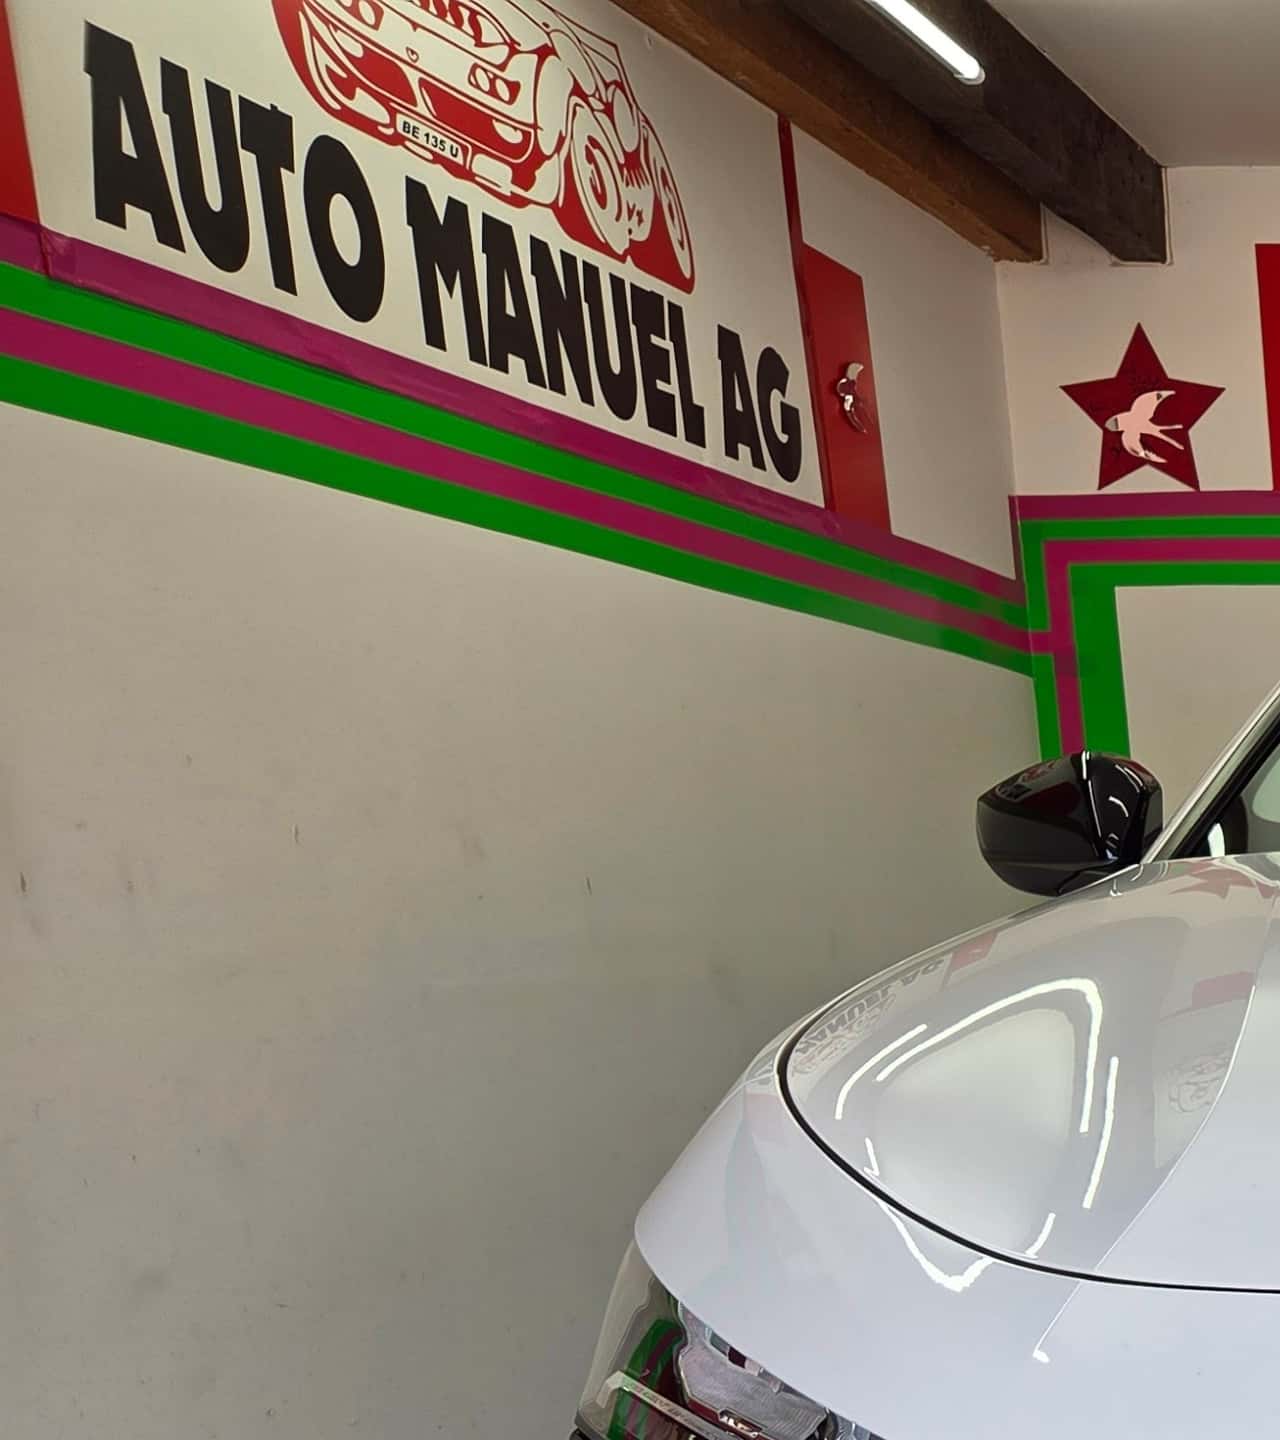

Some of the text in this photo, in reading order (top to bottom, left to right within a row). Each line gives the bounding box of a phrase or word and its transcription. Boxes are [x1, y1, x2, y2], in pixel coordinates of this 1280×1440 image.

[84, 19, 803, 483] AUTO MANUEL AG
[402, 120, 459, 158] BE 135 U
